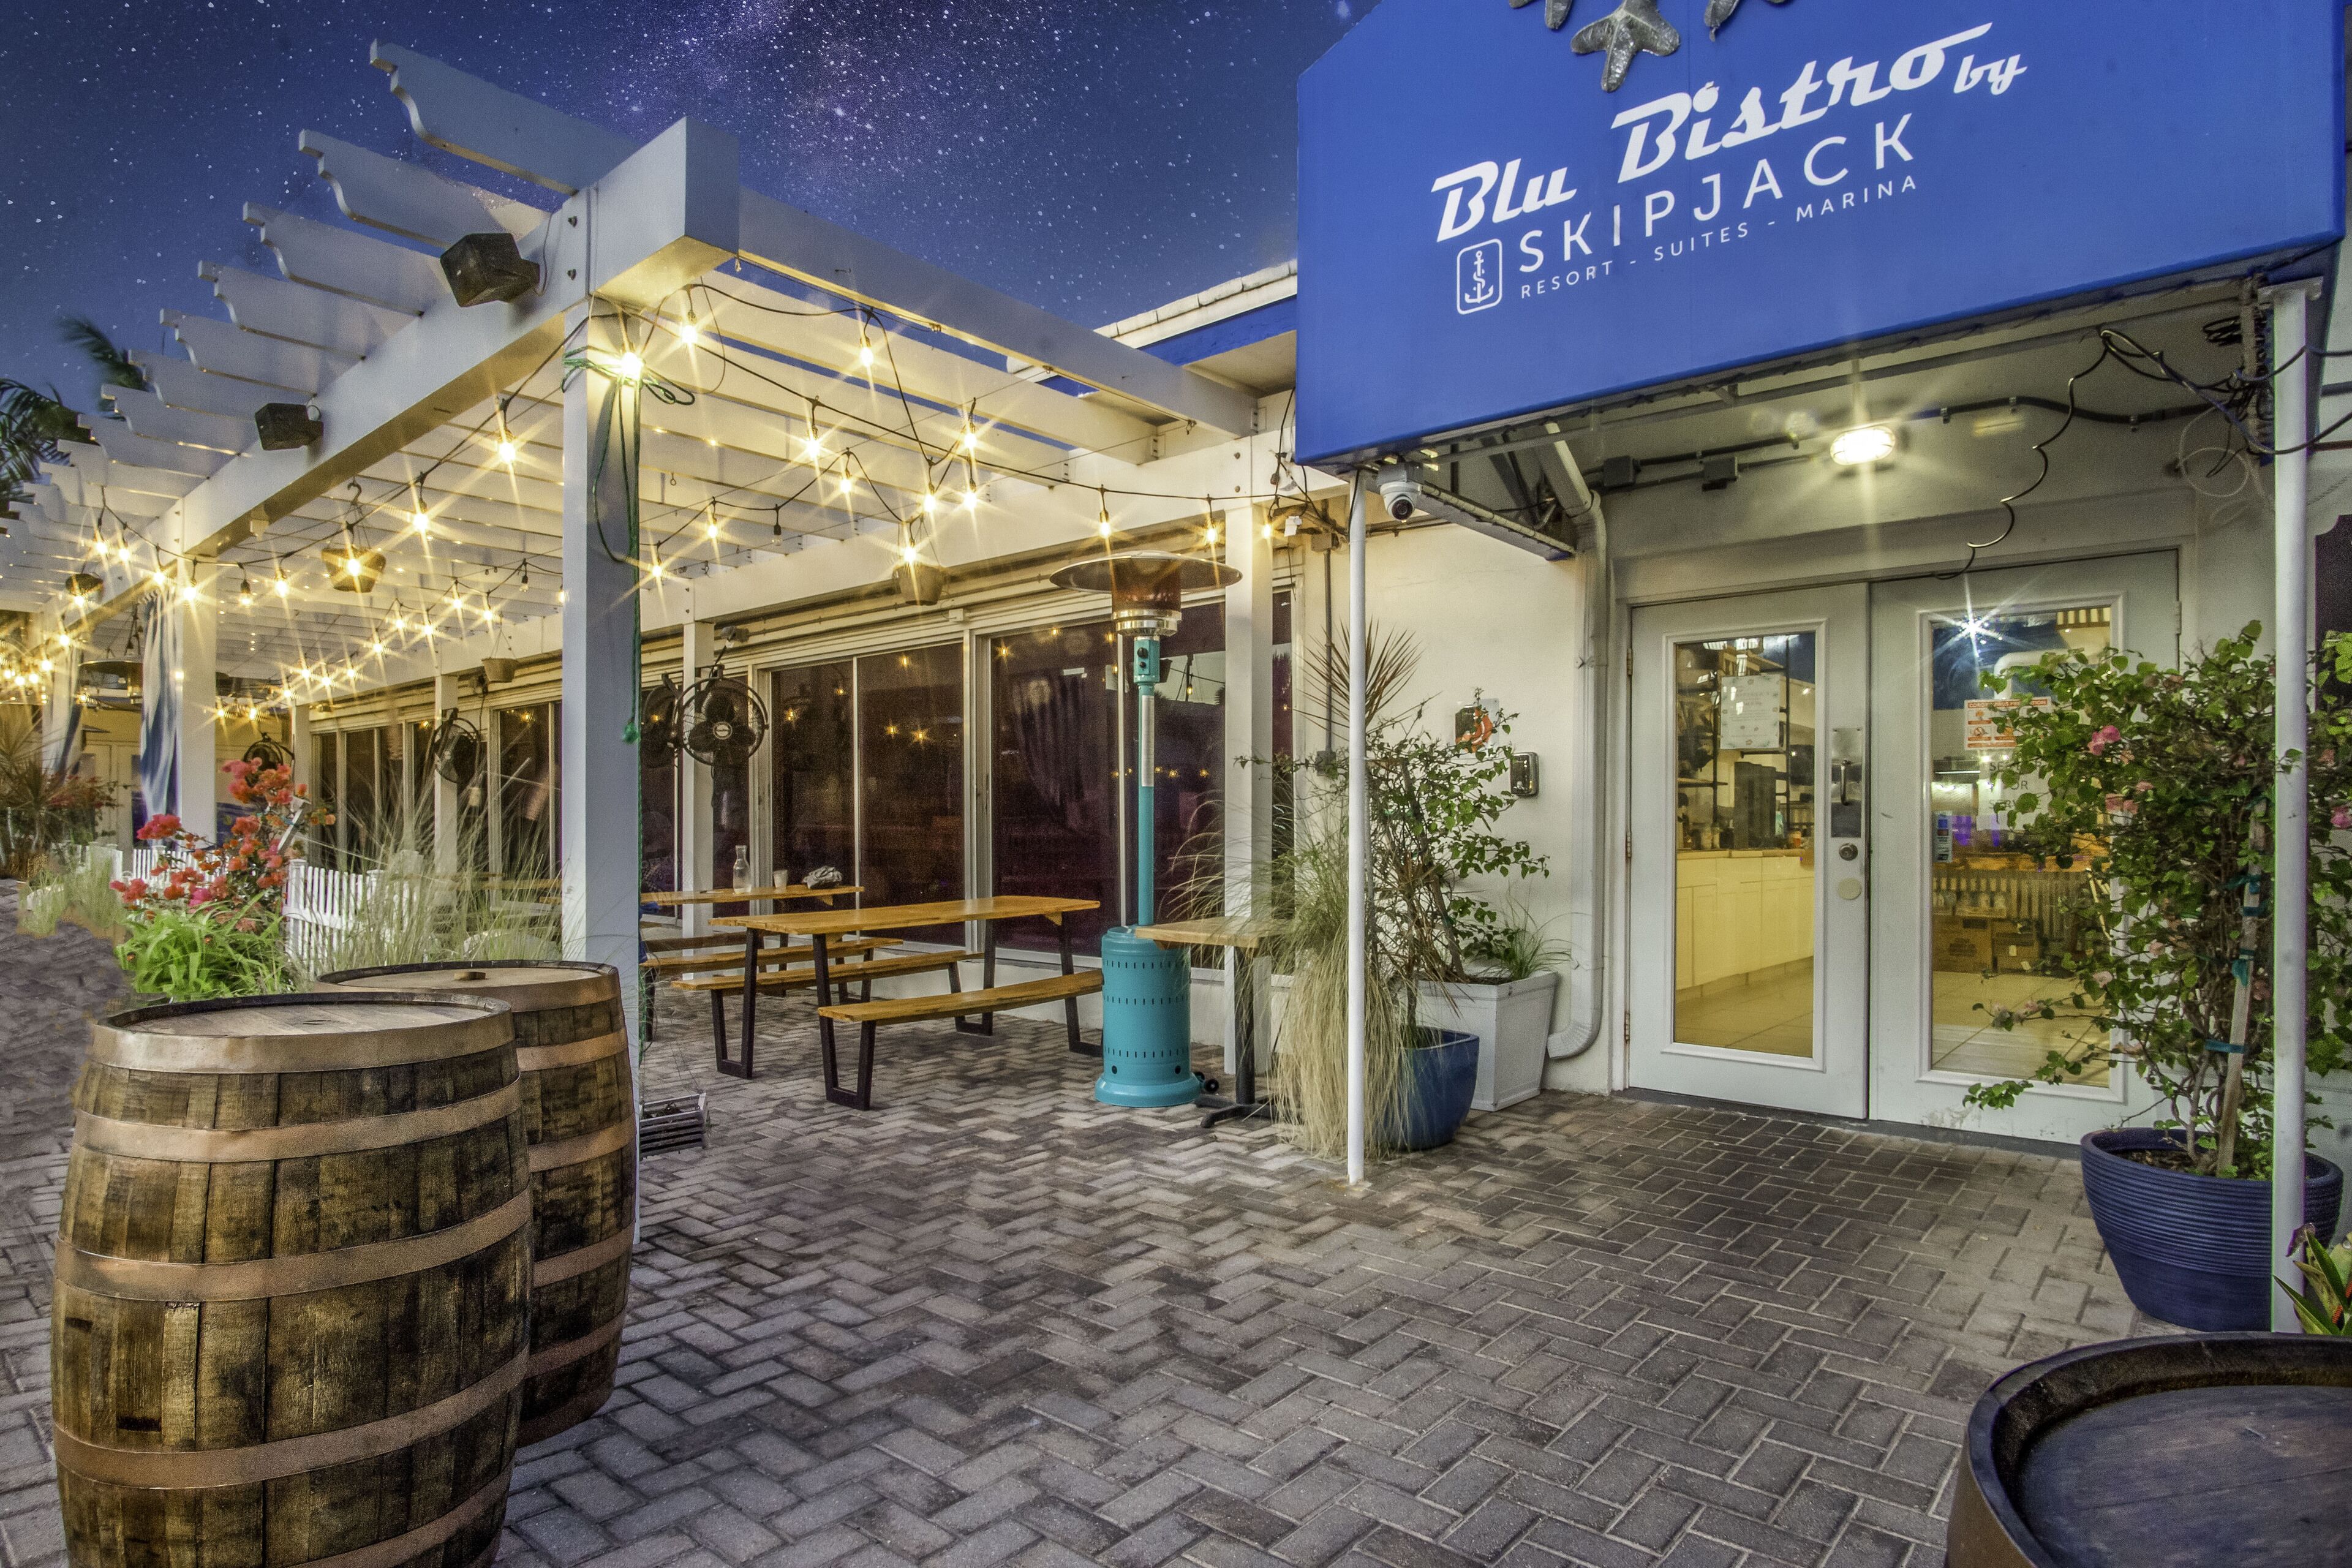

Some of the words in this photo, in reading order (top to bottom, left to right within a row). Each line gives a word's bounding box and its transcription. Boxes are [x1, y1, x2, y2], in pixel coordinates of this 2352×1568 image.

[1430, 158, 1577, 243] Blu
[1610, 22, 1992, 184] Bistro
[1953, 54, 2027, 96] by
[1519, 113, 1913, 273] SKIPJACK
[1521, 260, 1613, 299] RESORT
[1654, 221, 1749, 262] SUITES
[1796, 175, 1916, 222] MARINA
